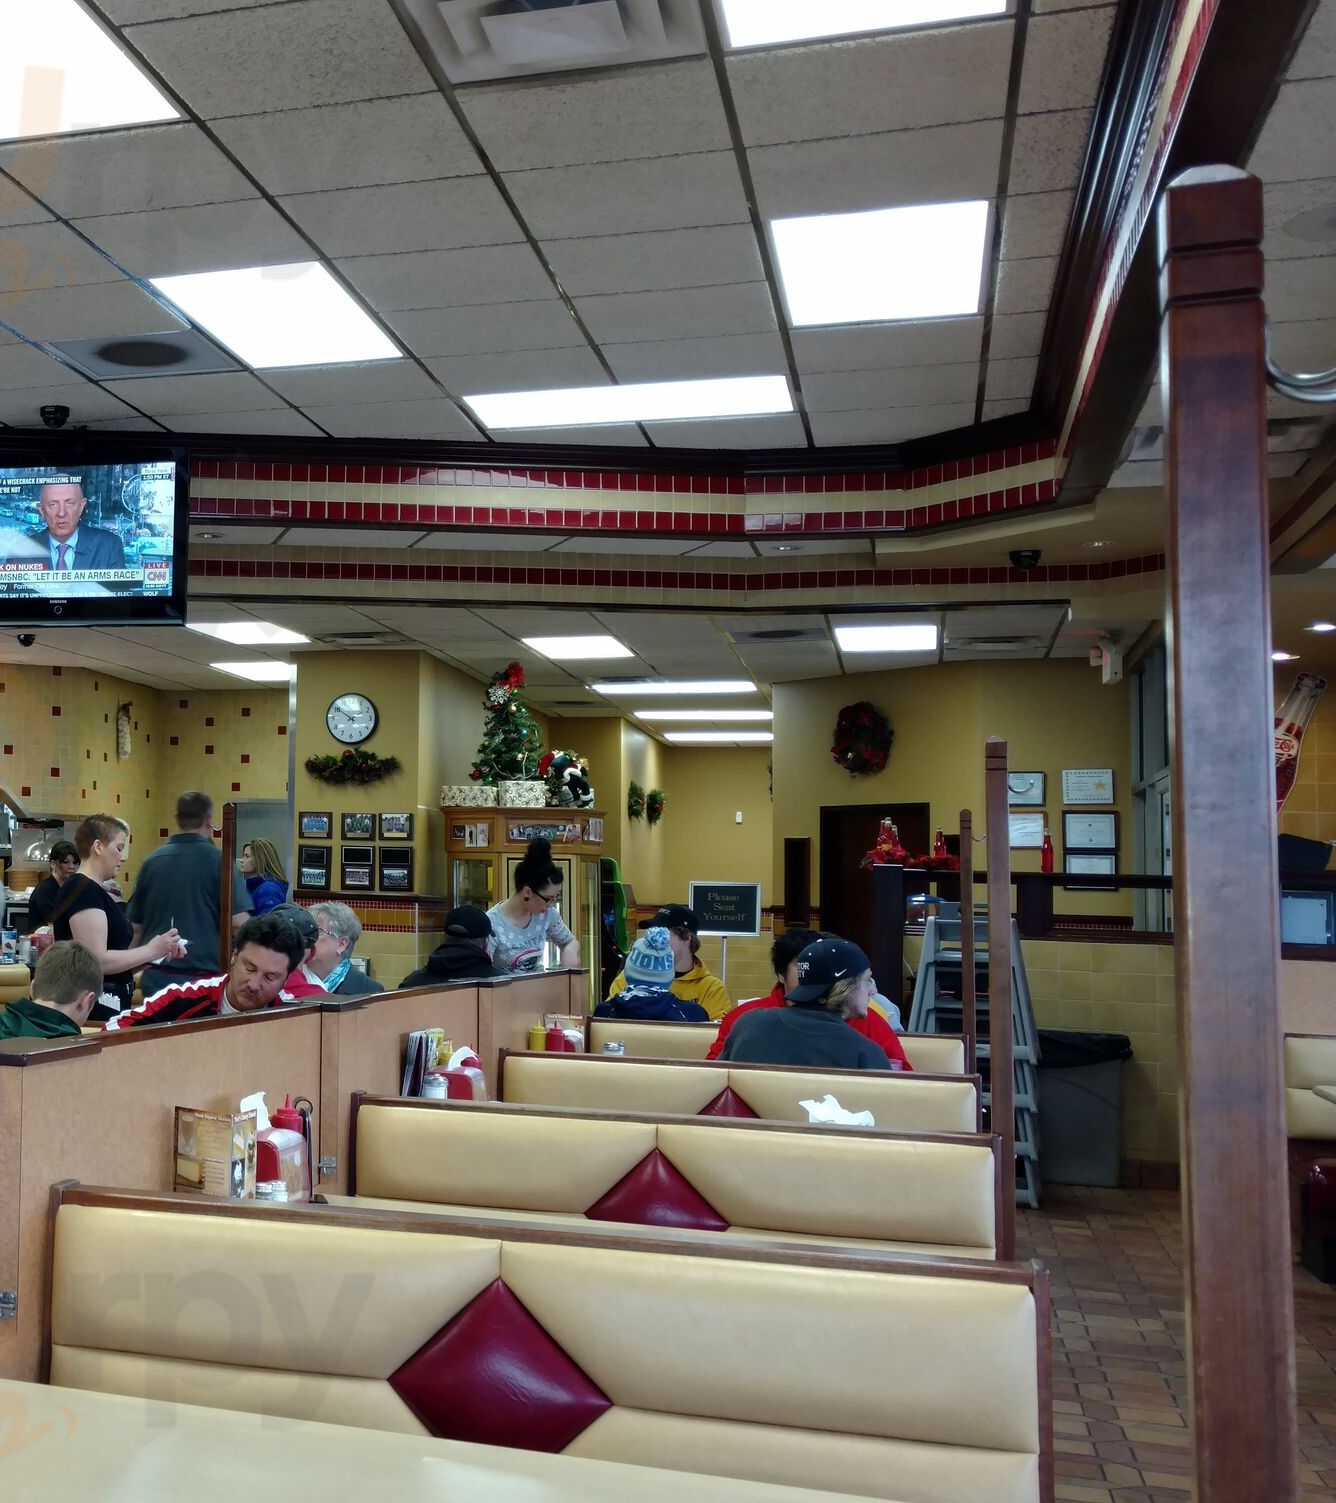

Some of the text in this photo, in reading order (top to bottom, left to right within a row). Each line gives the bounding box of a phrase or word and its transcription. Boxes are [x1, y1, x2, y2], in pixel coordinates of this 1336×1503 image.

[36, 476, 68, 484] EMPHASIZING
[18, 563, 44, 571] NUKES
[0, 573, 31, 581] MSNBC:
[32, 572, 51, 581] "LET
[52, 572, 60, 580] IT
[61, 572, 72, 580] BE
[73, 572, 86, 580] AN
[87, 571, 112, 580] ARMS
[113, 570, 140, 579] RACE"
[146, 571, 167, 582] CNN
[707, 892, 740, 901] Please
[713, 902, 737, 911] Seat
[703, 912, 747, 921] Yourself
